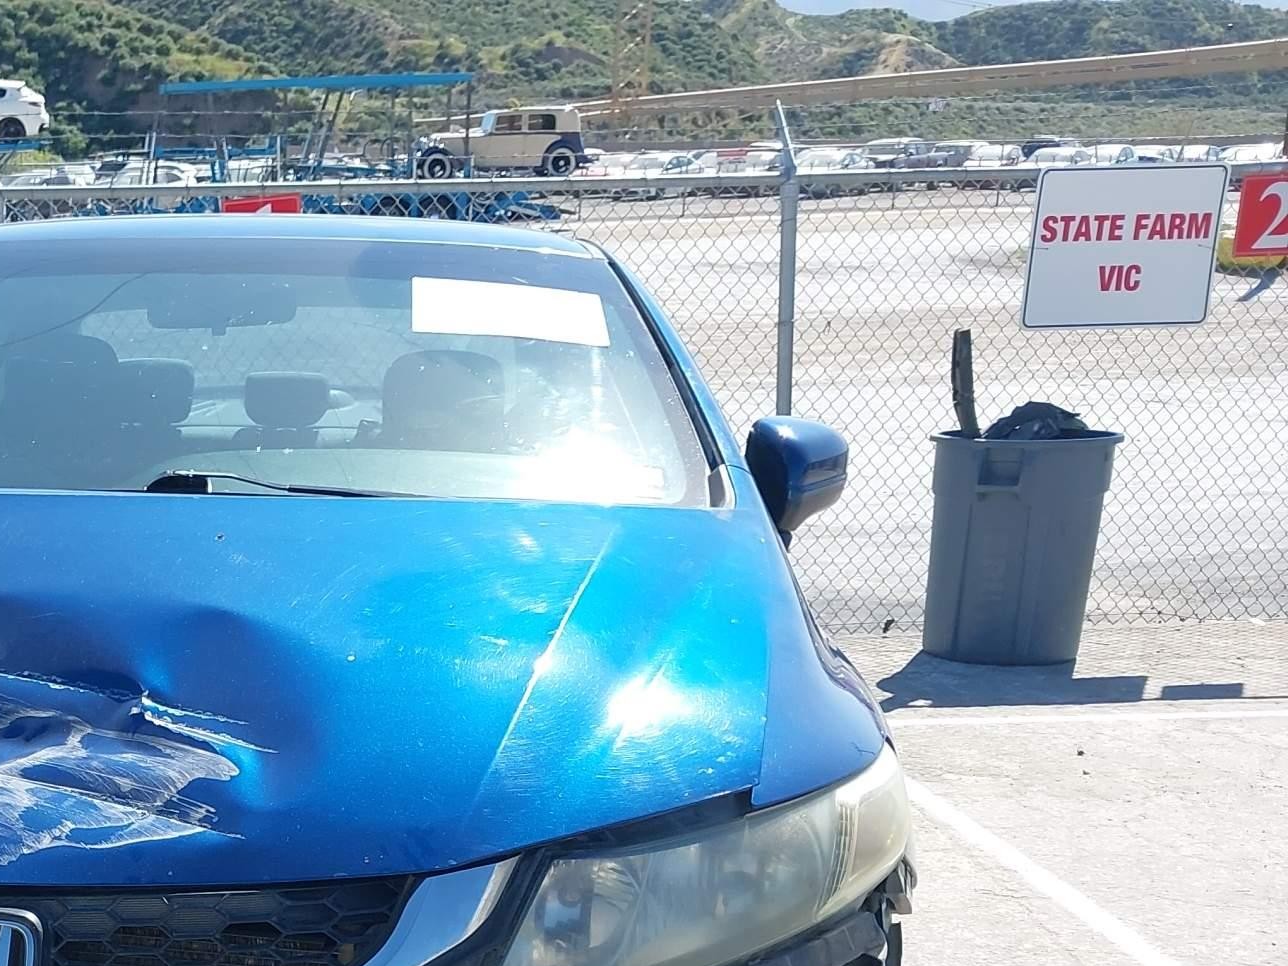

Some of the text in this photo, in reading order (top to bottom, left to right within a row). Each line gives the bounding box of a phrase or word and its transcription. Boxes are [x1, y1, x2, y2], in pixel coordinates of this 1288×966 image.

[1040, 212, 1212, 243] STATE FARM
[1098, 264, 1142, 292] VIC
